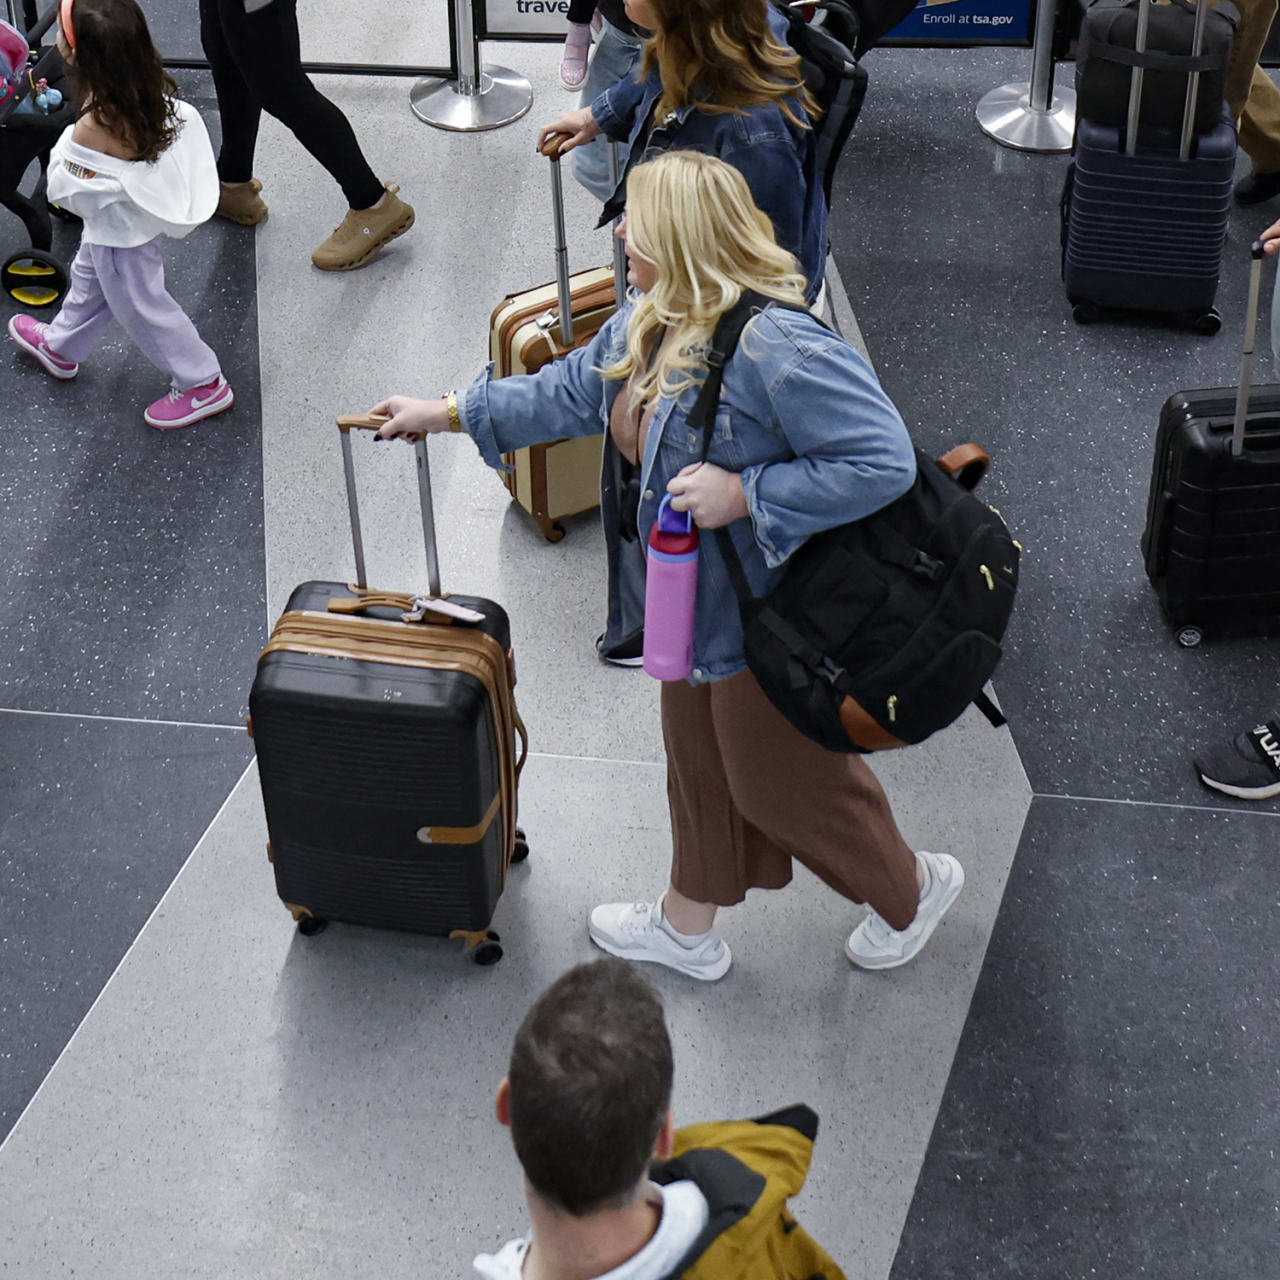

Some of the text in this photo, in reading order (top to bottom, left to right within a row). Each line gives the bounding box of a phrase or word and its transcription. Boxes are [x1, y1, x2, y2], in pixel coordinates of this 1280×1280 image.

[923, 13, 1014, 26] Enroll at tsa.gov
